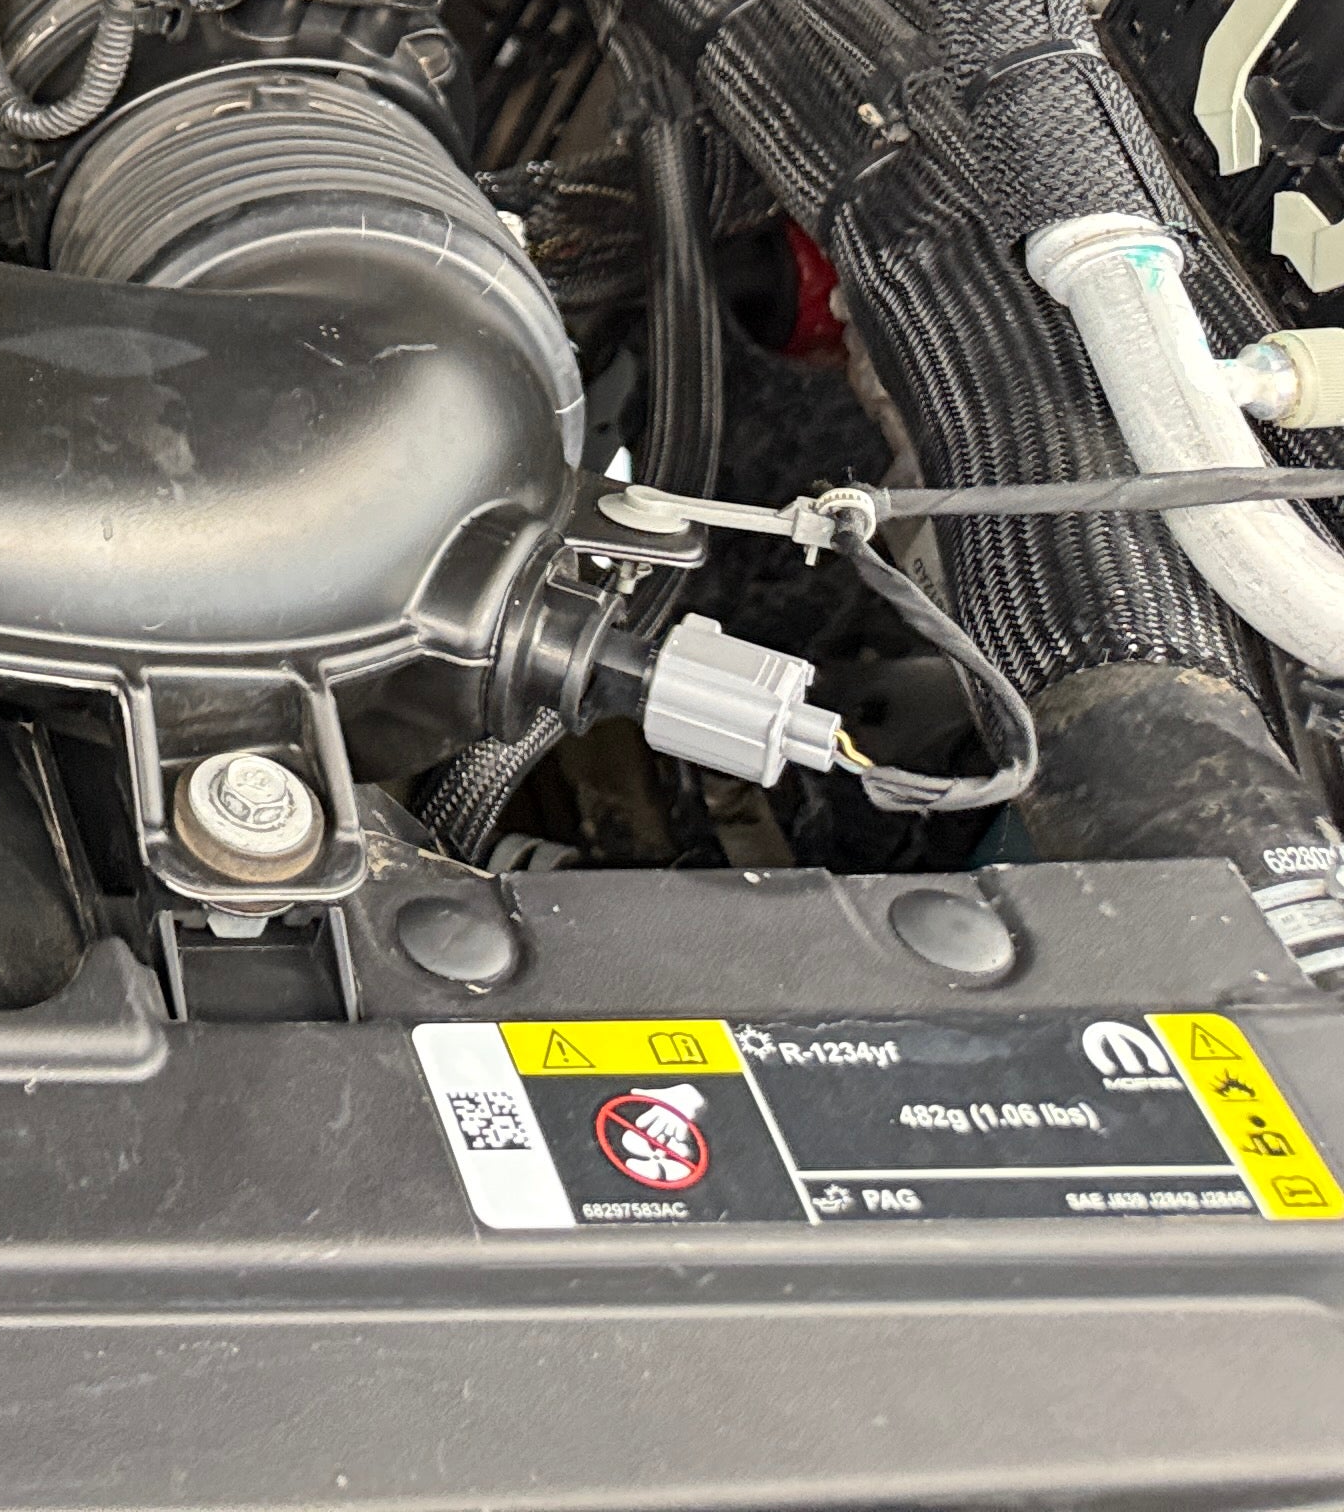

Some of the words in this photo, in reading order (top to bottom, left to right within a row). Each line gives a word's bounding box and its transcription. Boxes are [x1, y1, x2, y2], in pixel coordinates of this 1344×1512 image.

[778, 1040, 900, 1068] R-1234yf
[899, 1104, 971, 1133] 482g
[969, 1102, 1041, 1134] (1.06
[1042, 1101, 1102, 1131] lbs)
[582, 1202, 689, 1220] 68297583AC
[861, 1189, 922, 1213] PAG
